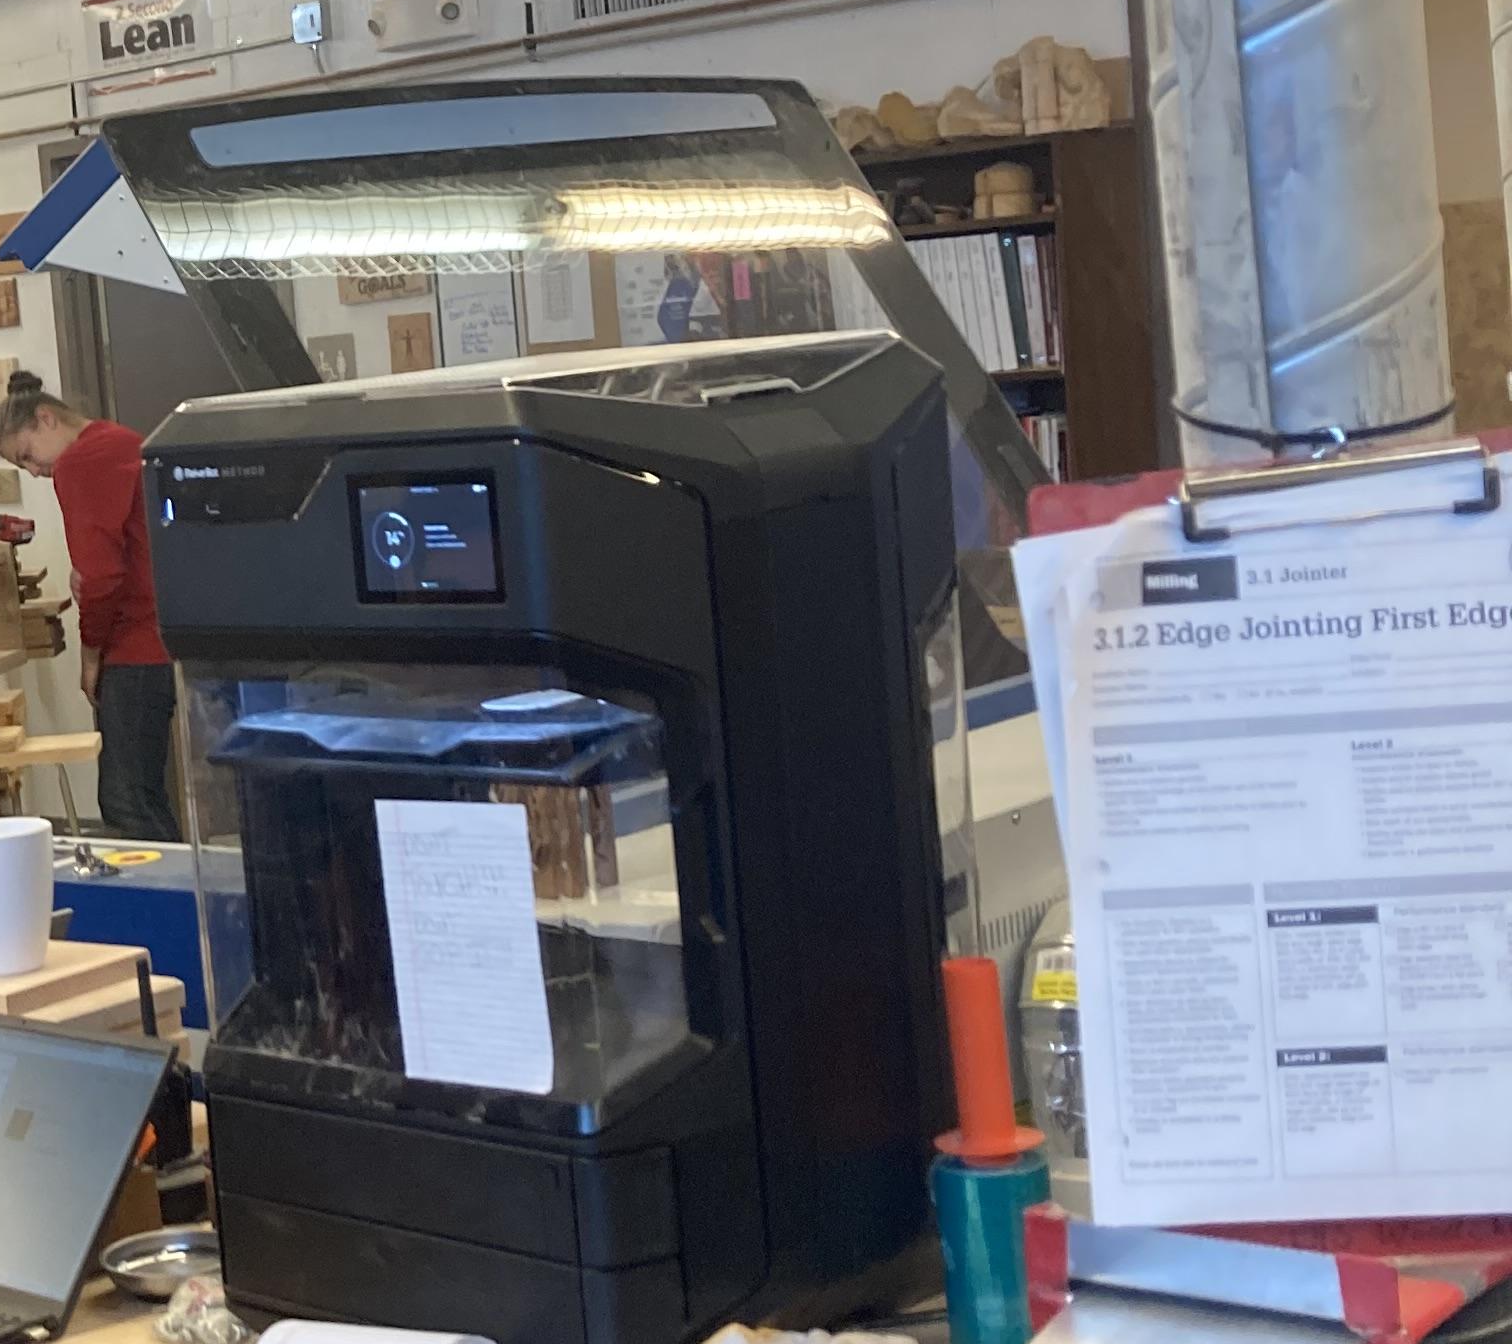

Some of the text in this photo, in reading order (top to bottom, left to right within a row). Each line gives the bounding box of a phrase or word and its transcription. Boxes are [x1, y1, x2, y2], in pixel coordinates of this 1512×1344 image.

[115, 5, 125, 20] 2
[99, 13, 196, 61] Lean
[1246, 565, 1348, 585] 3.1 Jointer
[1093, 601, 1512, 651] 3.1.2 Edge Jointing First Edg
